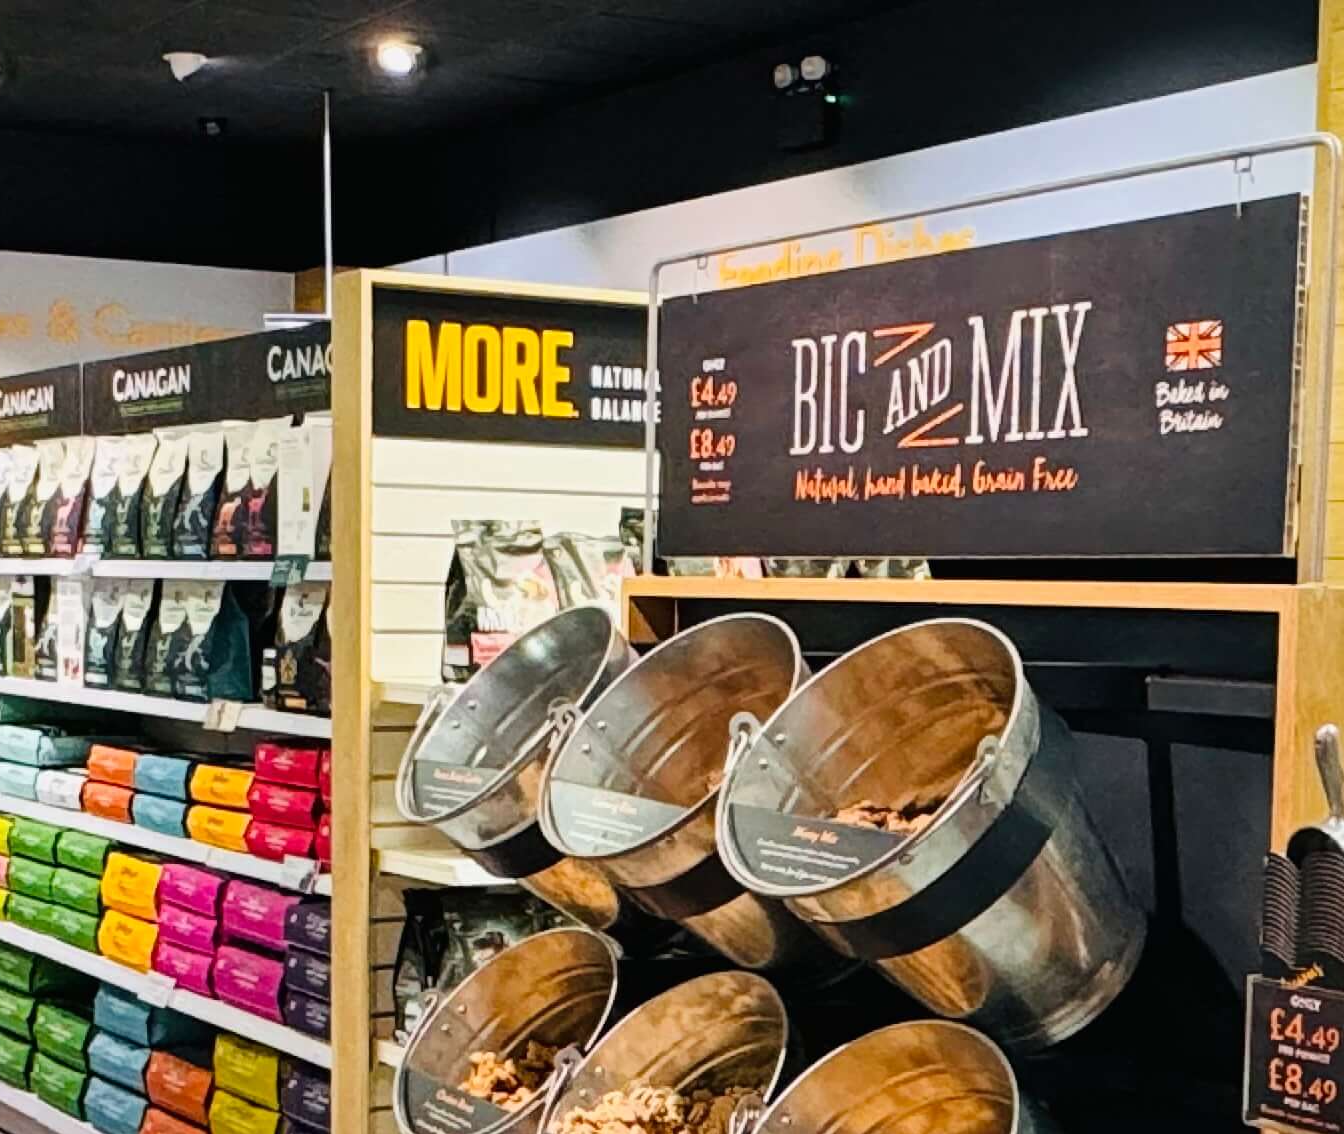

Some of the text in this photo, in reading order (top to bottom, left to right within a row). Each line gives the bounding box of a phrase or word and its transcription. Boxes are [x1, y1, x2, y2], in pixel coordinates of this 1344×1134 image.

[112, 364, 191, 402] CANAGAN
[691, 376, 737, 408] £4.49
[883, 338, 952, 434] AND
[965, 301, 1092, 444] MIX
[1159, 409, 1224, 435] Britain
[690, 428, 736, 459] £8.49
[972, 459, 1025, 496] Grain
[1032, 456, 1080, 491] Free
[1269, 1007, 1340, 1052] £4.49
[1267, 1057, 1338, 1104] £8.49
